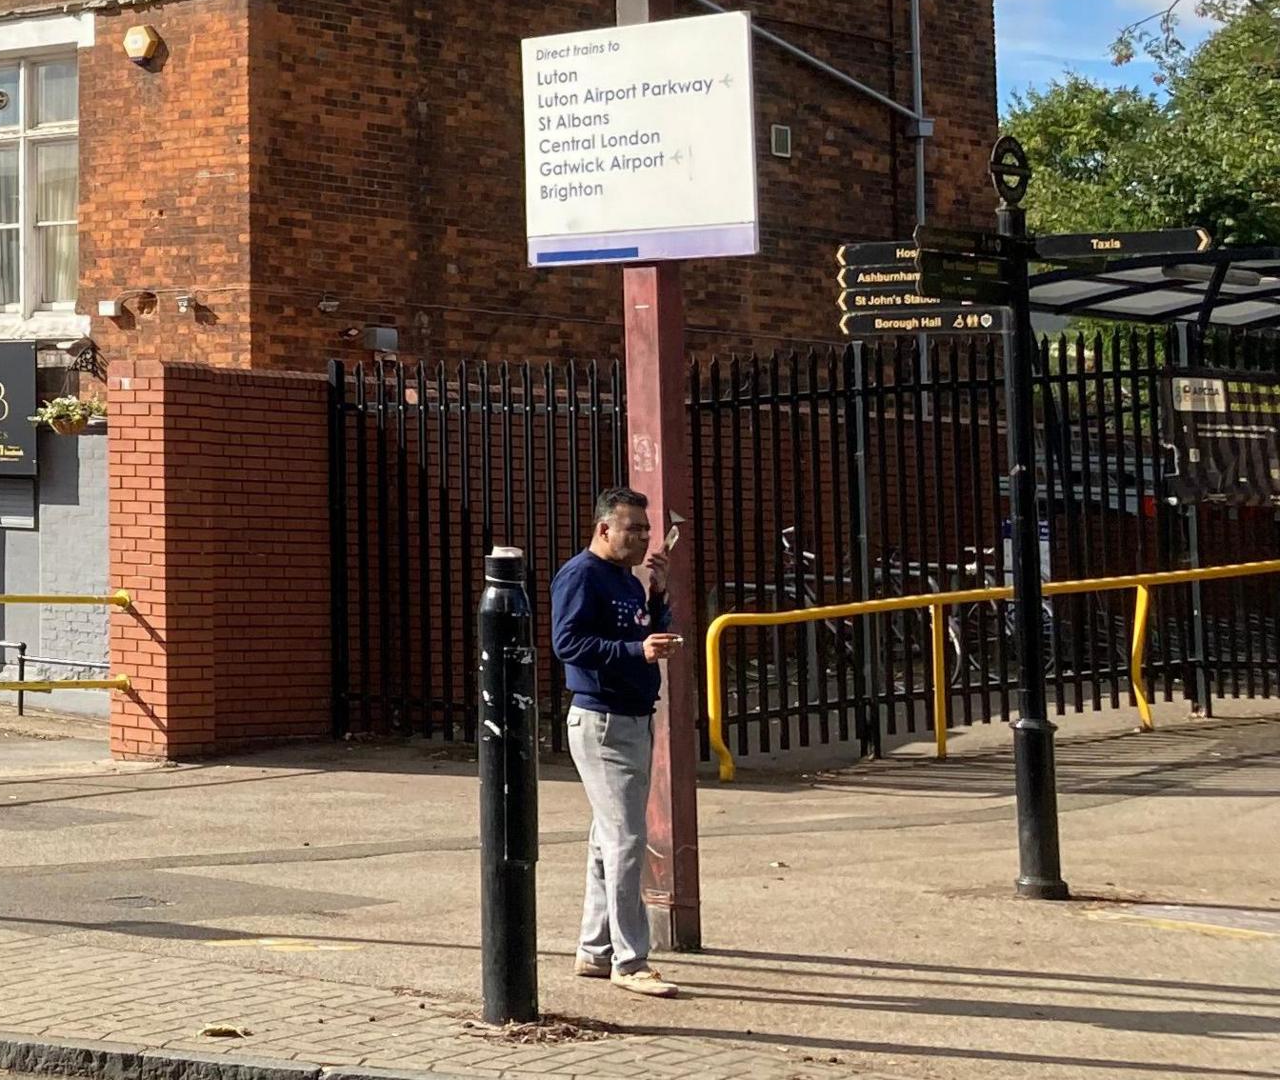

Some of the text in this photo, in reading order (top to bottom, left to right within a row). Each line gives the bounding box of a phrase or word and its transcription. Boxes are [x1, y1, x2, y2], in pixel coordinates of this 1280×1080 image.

[536, 40, 620, 61] Direct trains to
[537, 69, 578, 86] Luton
[538, 77, 714, 108] Luton Airport Parkway
[538, 112, 610, 132] St Albans
[539, 130, 661, 154] Central London
[540, 151, 665, 177] Gatwick Airport
[540, 182, 603, 202] Brighton
[1090, 238, 1121, 250] Taxis
[855, 296, 866, 306] St
[868, 294, 901, 305] John's
[875, 317, 942, 330] Borough Hall
